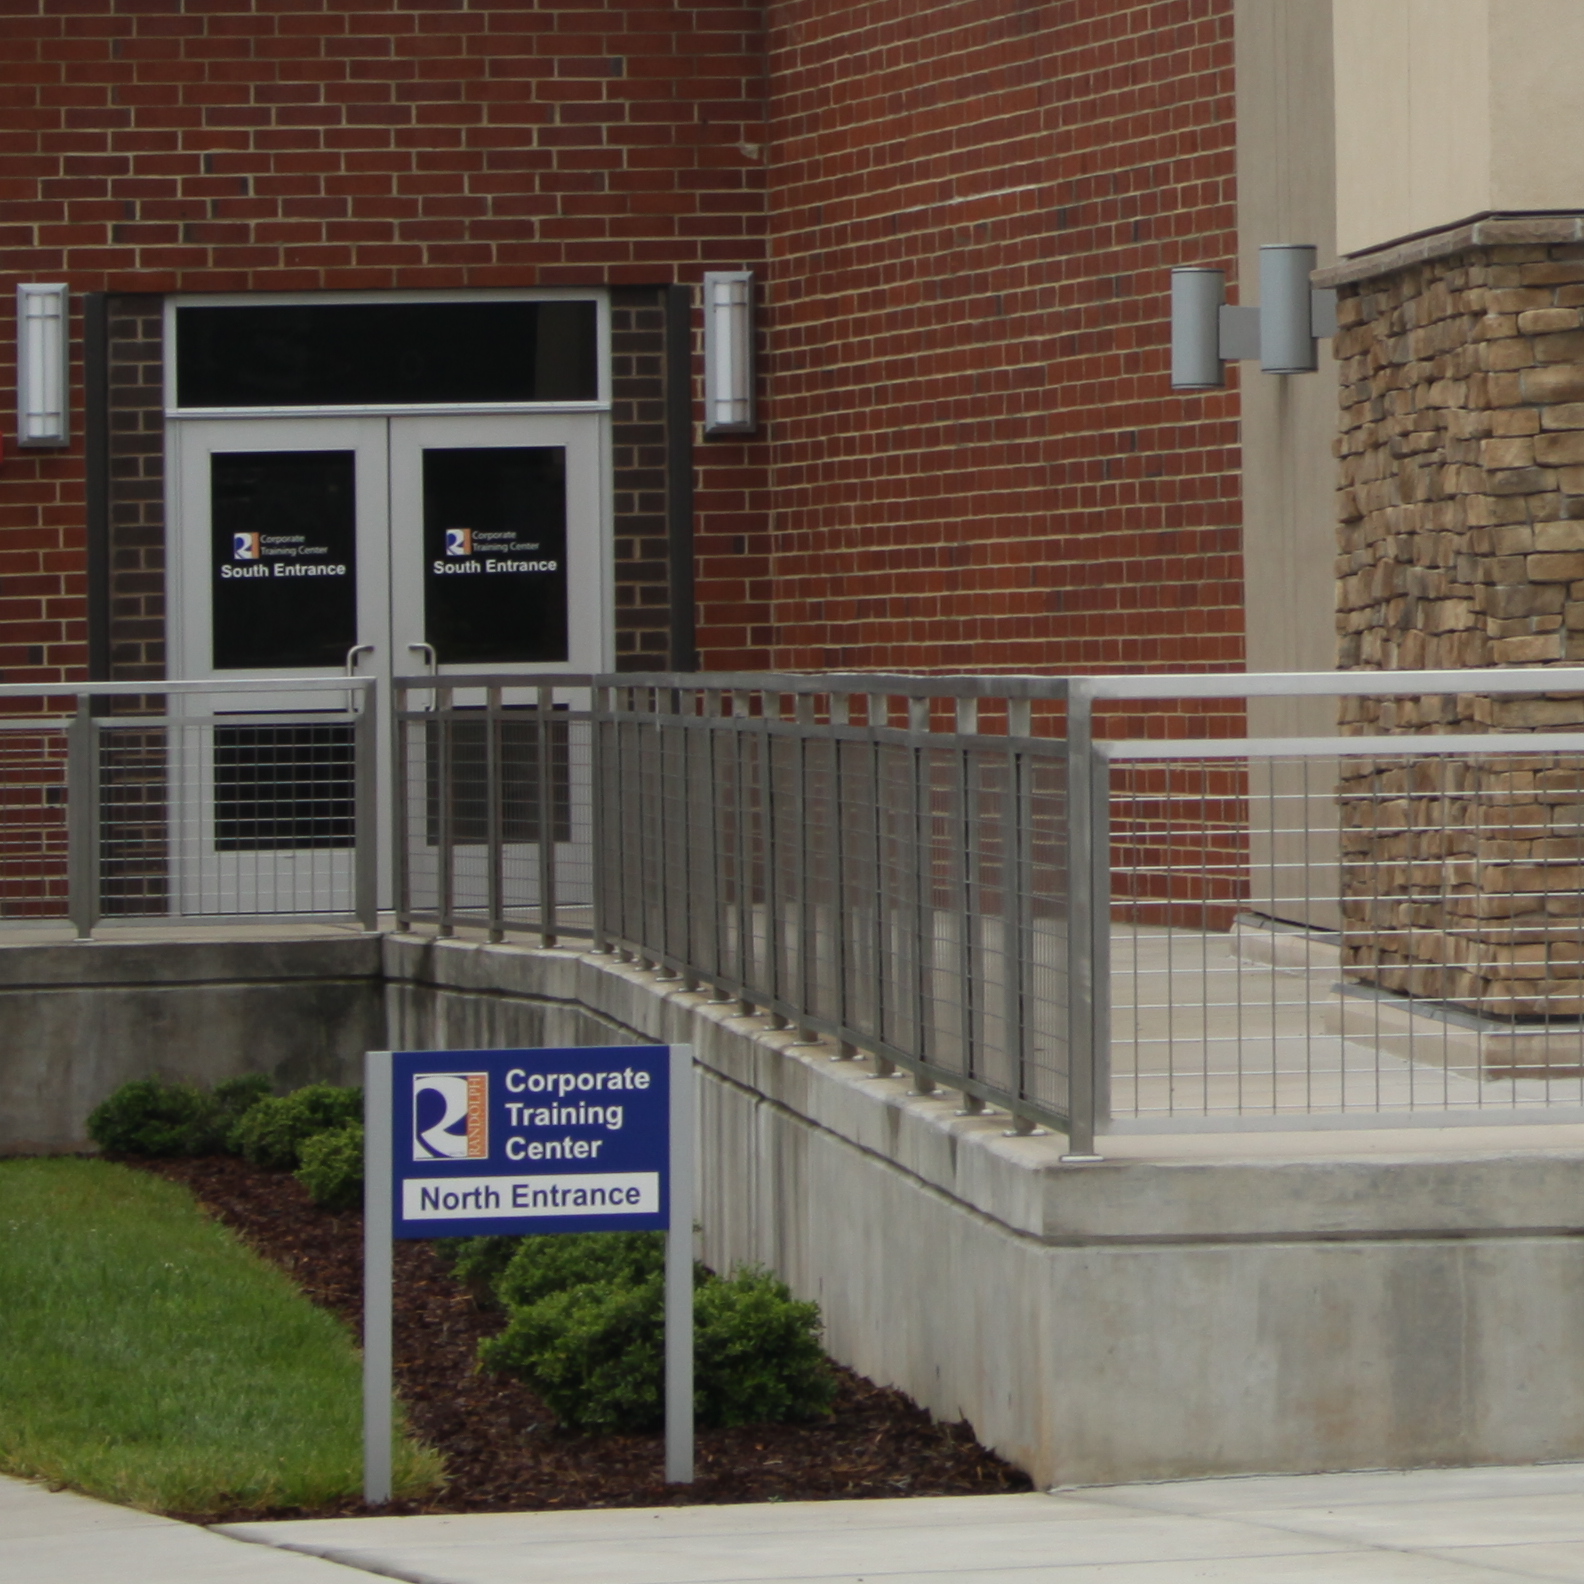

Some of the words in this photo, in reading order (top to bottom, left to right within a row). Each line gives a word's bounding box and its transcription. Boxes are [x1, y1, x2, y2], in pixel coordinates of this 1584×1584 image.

[259, 534, 306, 545] Corporate
[471, 530, 517, 541] Corporate
[260, 546, 298, 557] Training
[297, 545, 328, 555] Center
[472, 542, 509, 553] Training
[509, 541, 540, 551] Center
[220, 563, 270, 579] South
[273, 562, 346, 577] Entrance
[433, 560, 481, 575] South
[485, 558, 558, 573] Entrance
[505, 1067, 651, 1098] Corporate
[468, 1076, 482, 1156] RANDOLPH
[504, 1100, 623, 1131] Training
[505, 1136, 603, 1161] Center
[421, 1185, 500, 1211] North
[512, 1183, 641, 1209] Entrance
